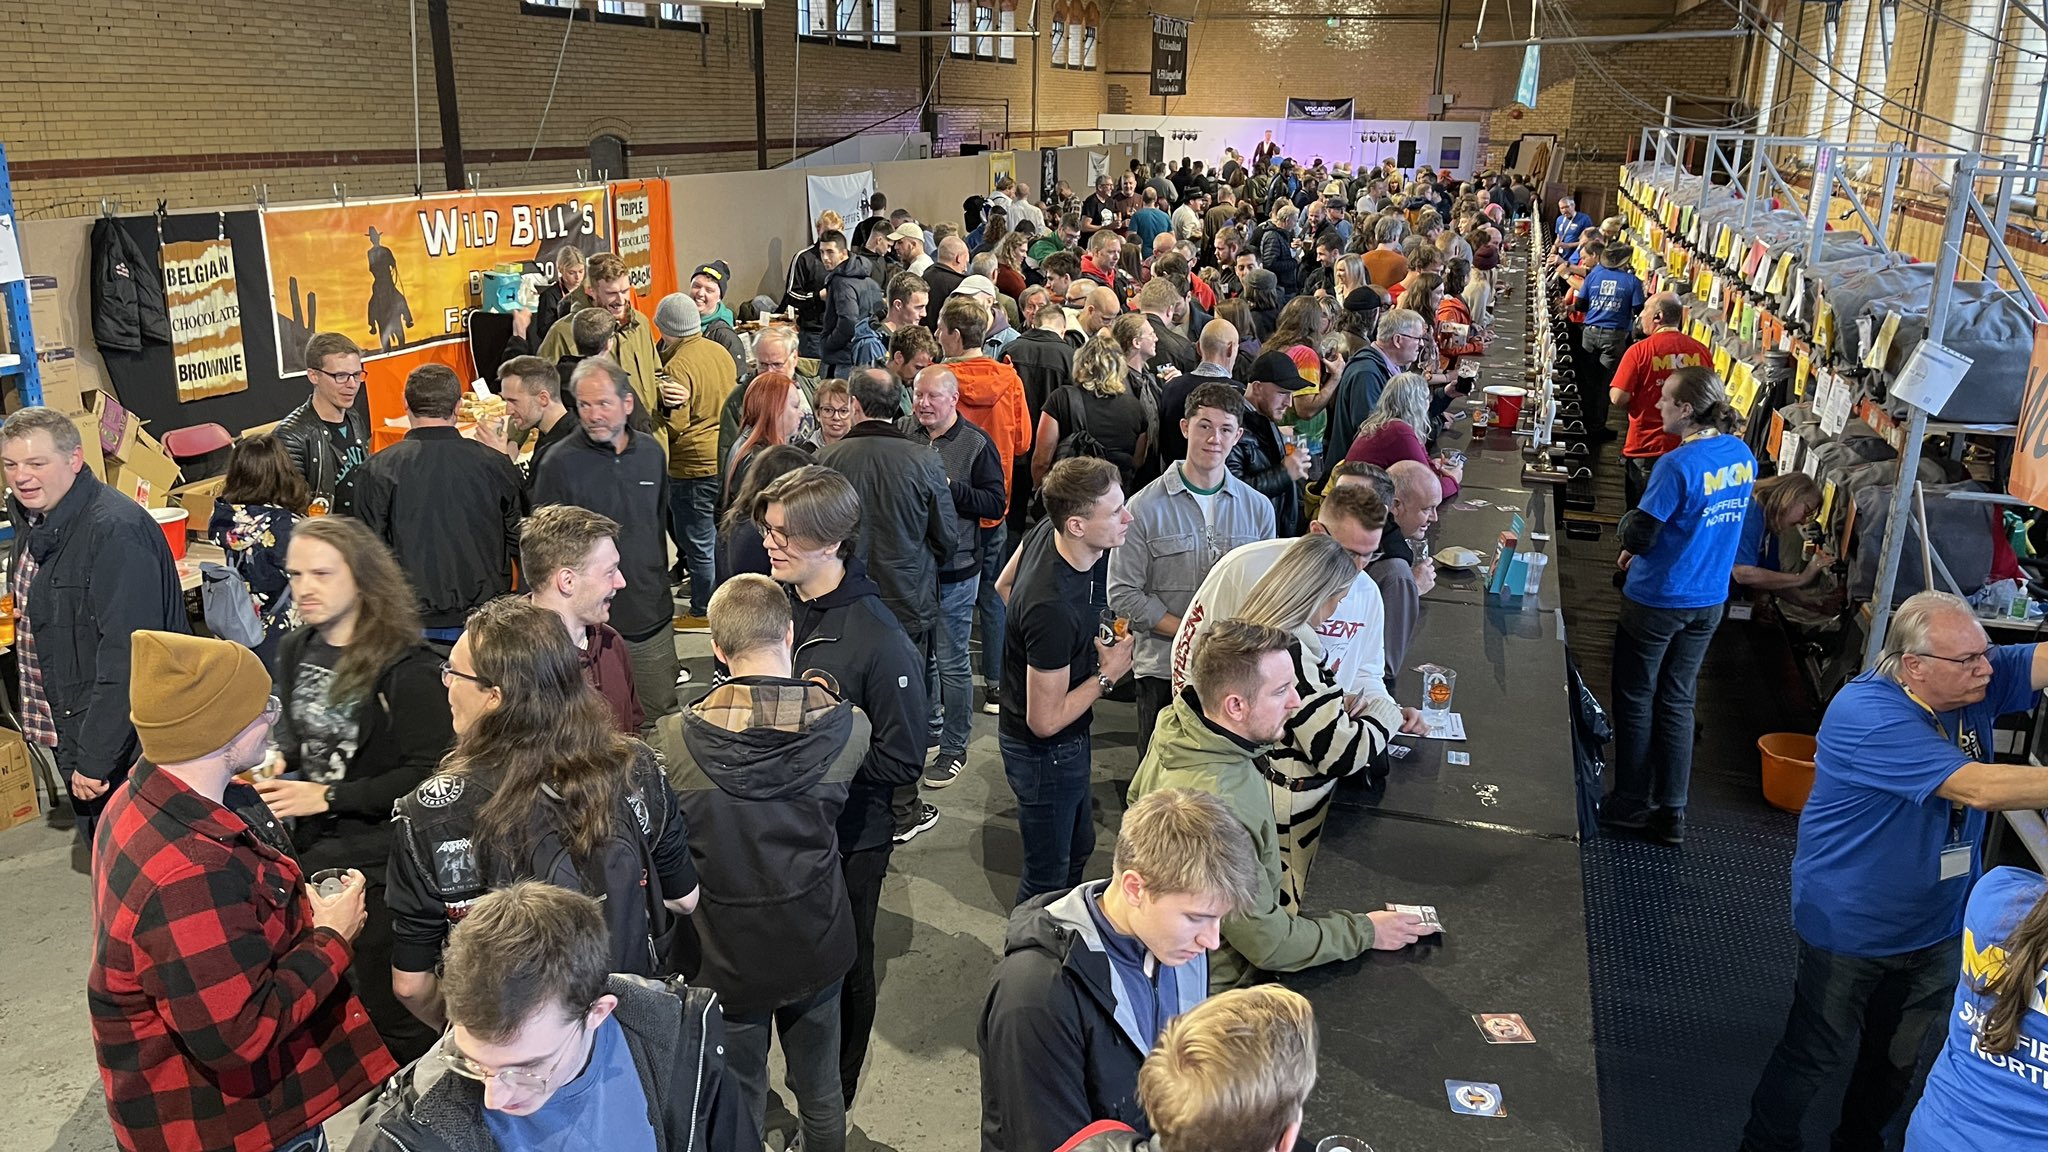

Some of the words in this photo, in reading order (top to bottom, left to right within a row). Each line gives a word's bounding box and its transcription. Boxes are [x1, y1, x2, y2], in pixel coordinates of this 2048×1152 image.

[620, 201, 643, 217] TRIPLE
[618, 233, 650, 248] CHOCOLATE
[166, 255, 229, 287] BELGIAN
[172, 305, 240, 332] CHOCOLATE
[178, 354, 242, 382] BROWNIE
[1652, 353, 1700, 372] MKM
[1703, 460, 1753, 496] MKM
[1702, 497, 1749, 518] SHEFFIELD
[1705, 511, 1742, 527] NORTH
